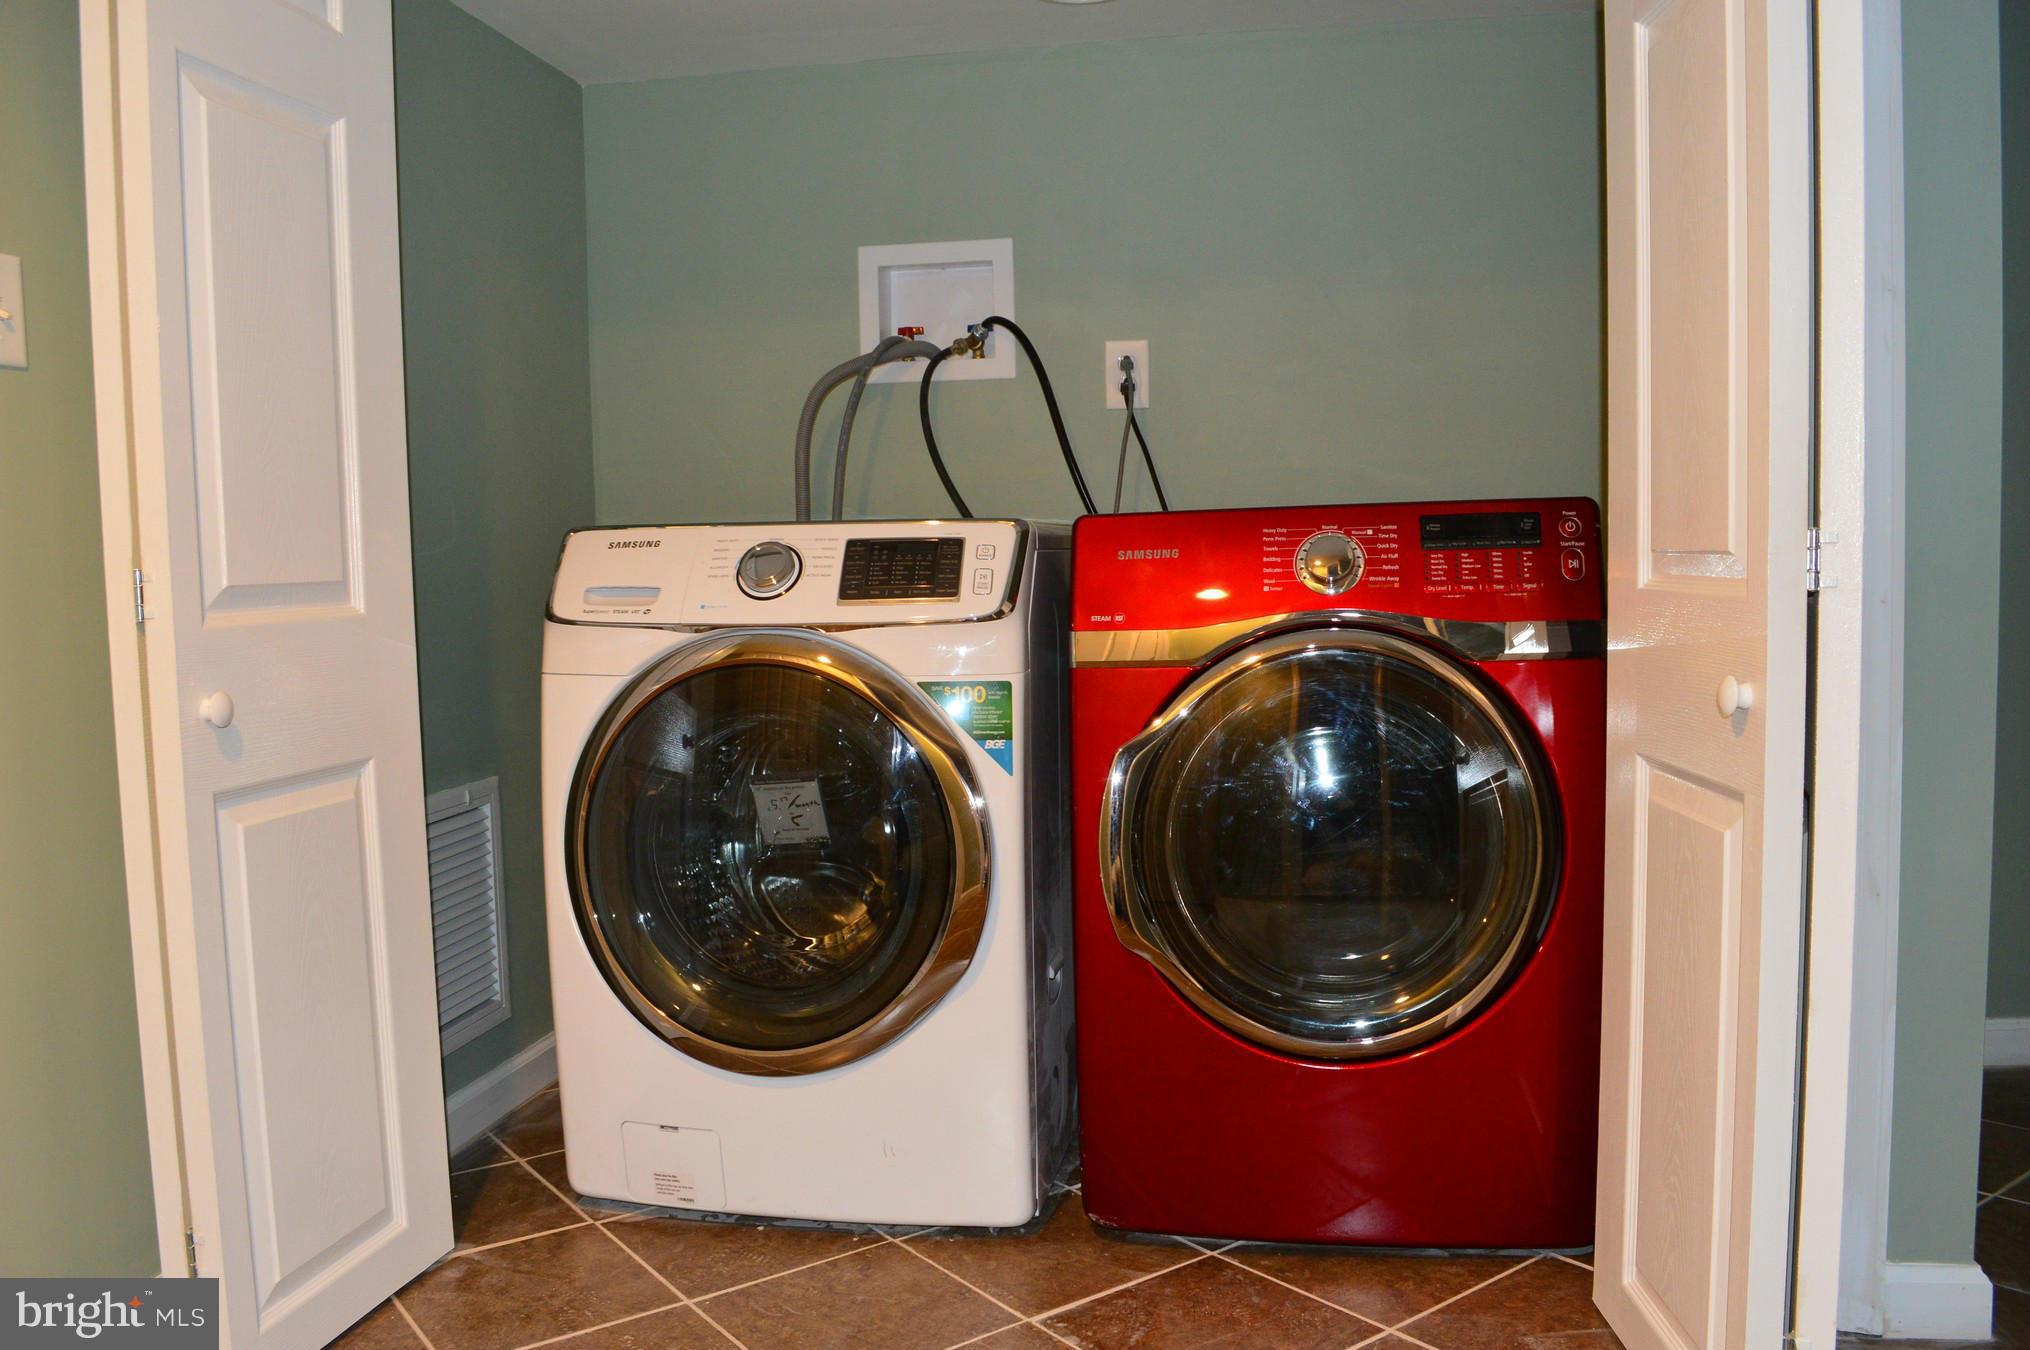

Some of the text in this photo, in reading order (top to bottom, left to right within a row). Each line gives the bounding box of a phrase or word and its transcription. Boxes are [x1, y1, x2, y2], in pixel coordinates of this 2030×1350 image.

[608, 540, 662, 549] SAMSUNG
[1117, 549, 1180, 561] SAMSUNG
[944, 685, 987, 704] $100
[984, 739, 1006, 750] BGE
